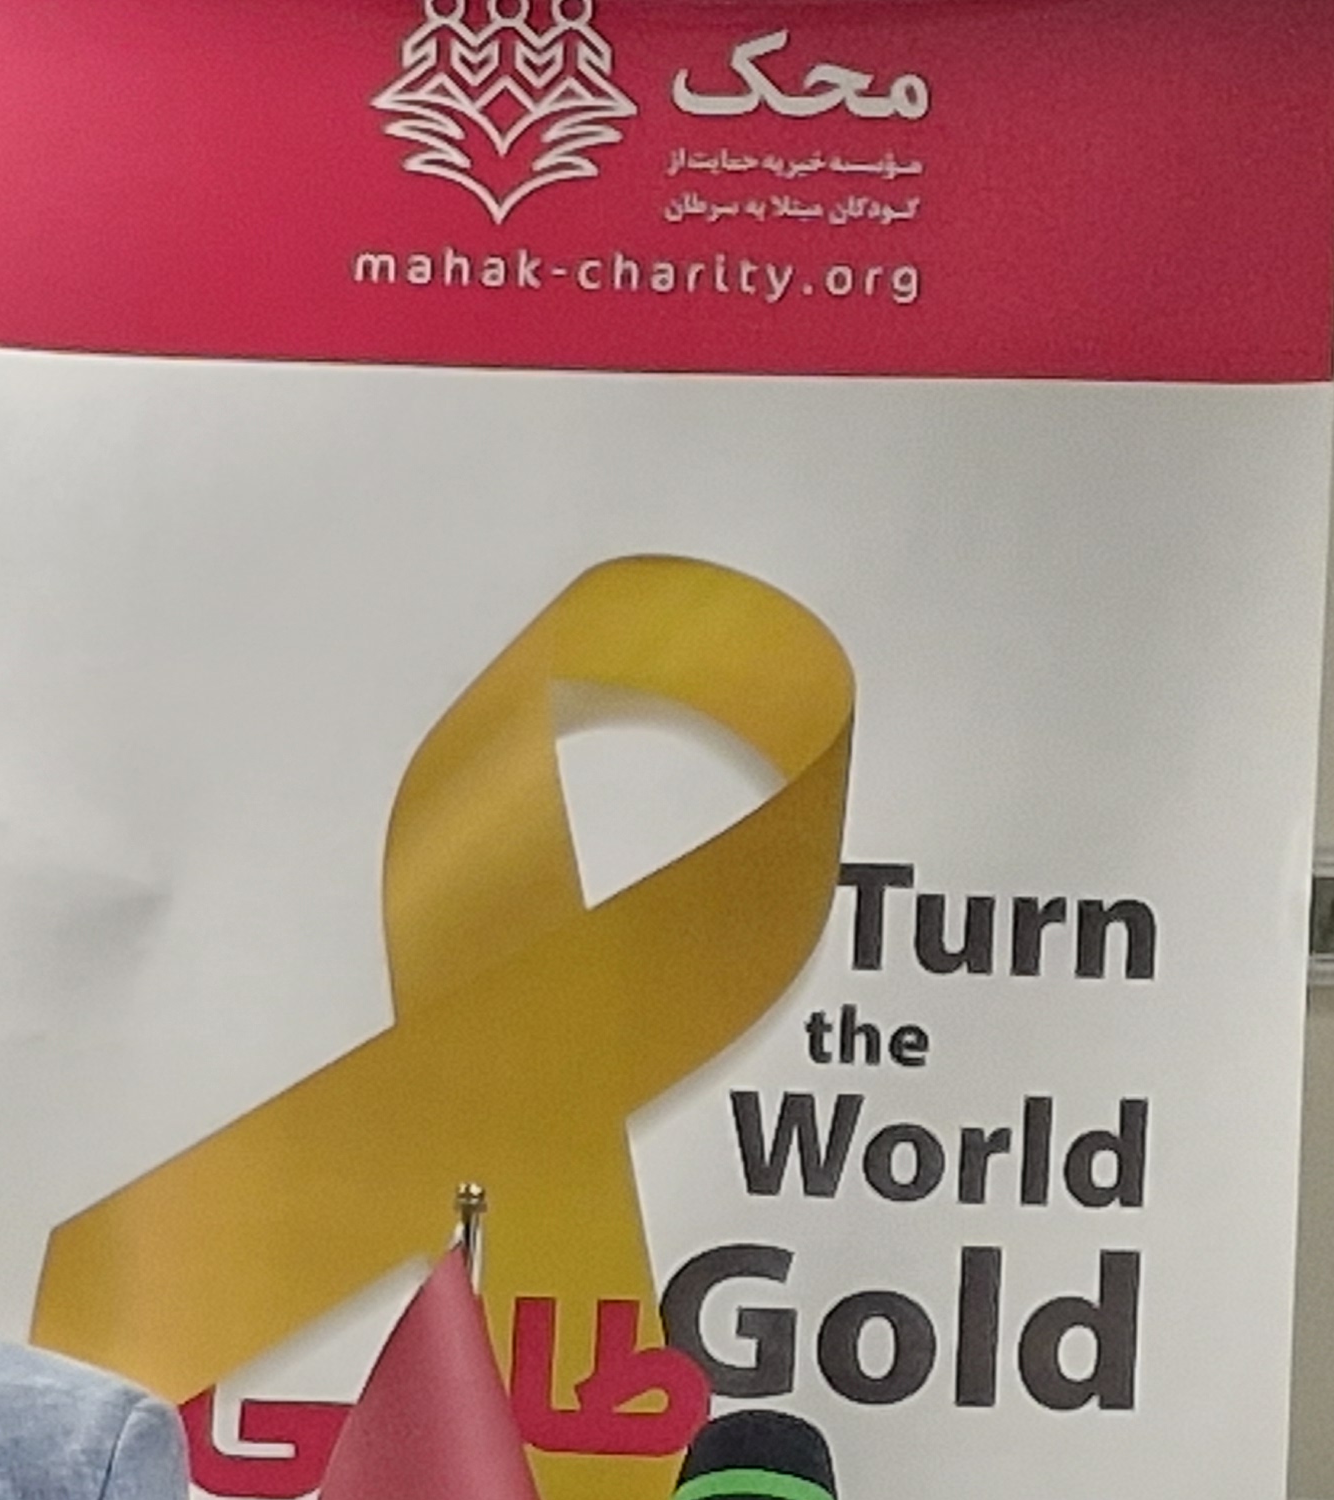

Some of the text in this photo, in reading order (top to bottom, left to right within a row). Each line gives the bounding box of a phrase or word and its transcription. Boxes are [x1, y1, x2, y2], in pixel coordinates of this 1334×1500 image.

[671, 28, 929, 120] محک
[666, 147, 687, 177] از
[686, 147, 760, 175] حمایت
[663, 191, 740, 223] سرطان
[744, 199, 767, 223] به
[352, 246, 920, 304] mahak-charity.org
[837, 862, 1158, 981] Turn
[804, 1004, 931, 1067] the
[729, 1088, 1150, 1209] World
[658, 1242, 1142, 1412] Gold
